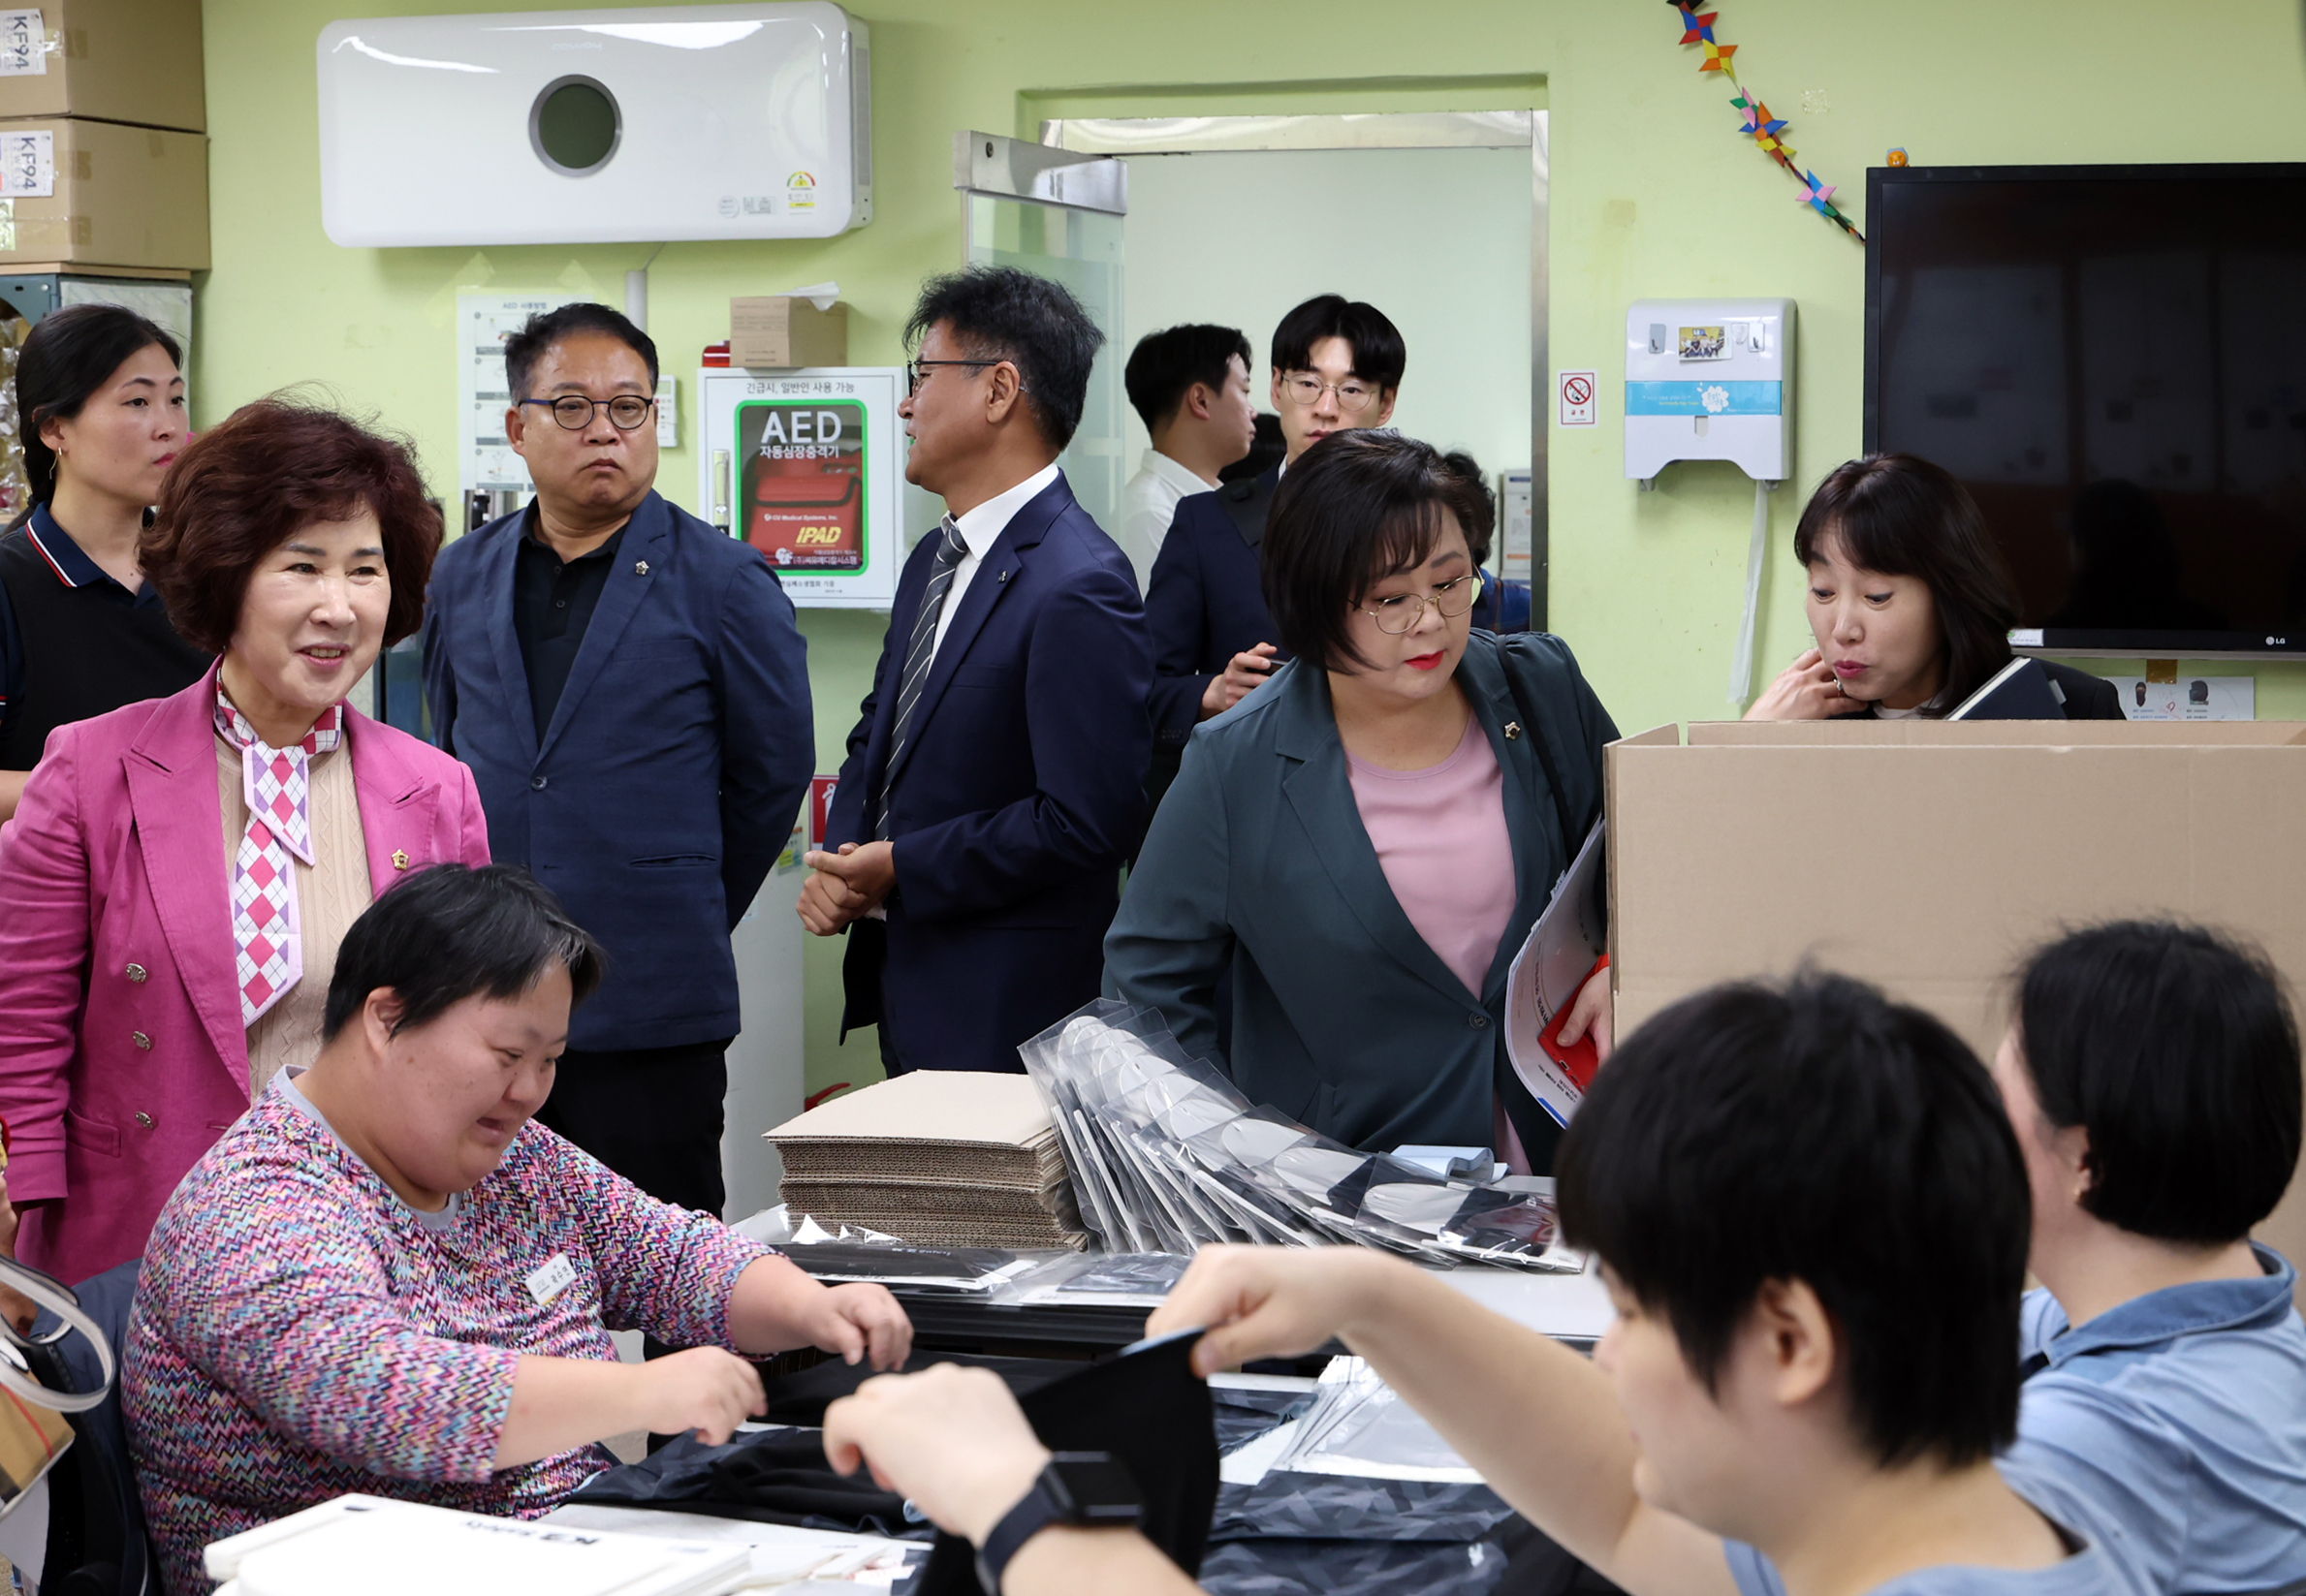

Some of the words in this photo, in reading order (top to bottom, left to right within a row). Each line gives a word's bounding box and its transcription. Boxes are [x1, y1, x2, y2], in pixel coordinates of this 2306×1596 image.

[14, 16, 29, 70] KF94
[21, 137, 37, 190] KF94
[746, 382, 778, 394] 긴급시,
[780, 382, 810, 394] 일반인
[812, 382, 832, 393] 사용
[836, 381, 855, 393] 가능
[760, 410, 842, 444] AED
[759, 444, 840, 459] 자동심장충격기
[795, 526, 842, 544] IPAD
